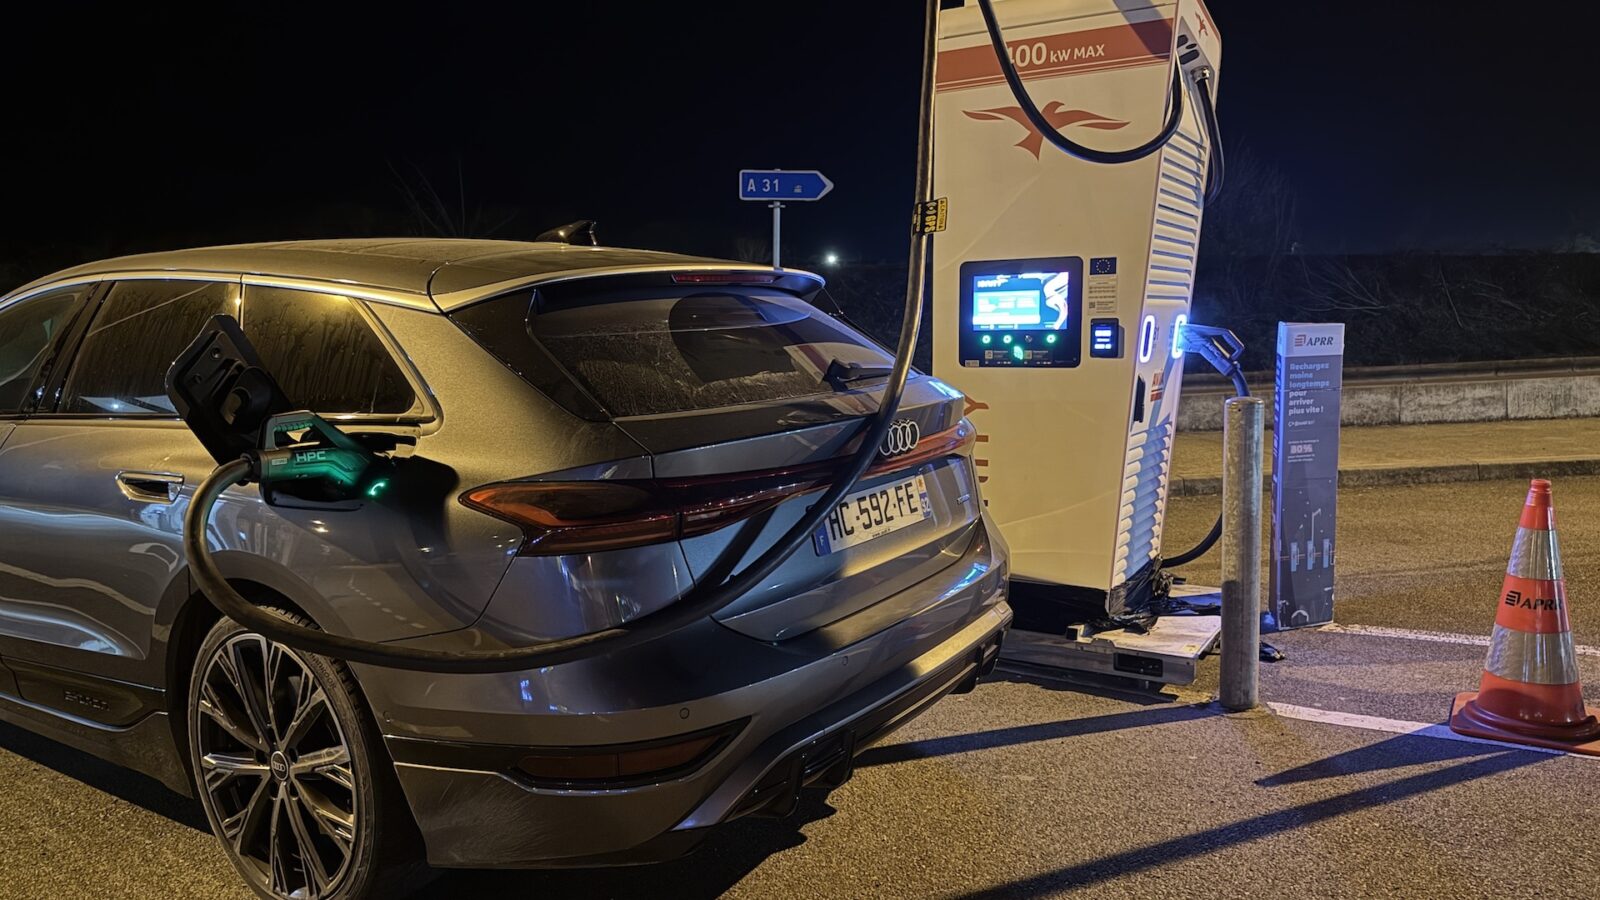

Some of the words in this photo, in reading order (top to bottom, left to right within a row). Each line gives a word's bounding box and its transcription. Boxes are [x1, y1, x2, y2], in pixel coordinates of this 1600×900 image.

[1050, 49, 1072, 63] kW
[1074, 44, 1105, 60] MAX
[747, 178, 756, 192] A
[762, 178, 780, 192] 31
[1307, 336, 1334, 346] APRR
[1290, 363, 1329, 371] Rechargez
[1290, 371, 1313, 379] moins
[1289, 380, 1330, 389] longtemps
[1289, 390, 1307, 399] pour
[1289, 398, 1314, 406] arriver
[1288, 407, 1305, 416] plus
[296, 451, 327, 463] HPC
[1520, 598, 1563, 611] APRR
